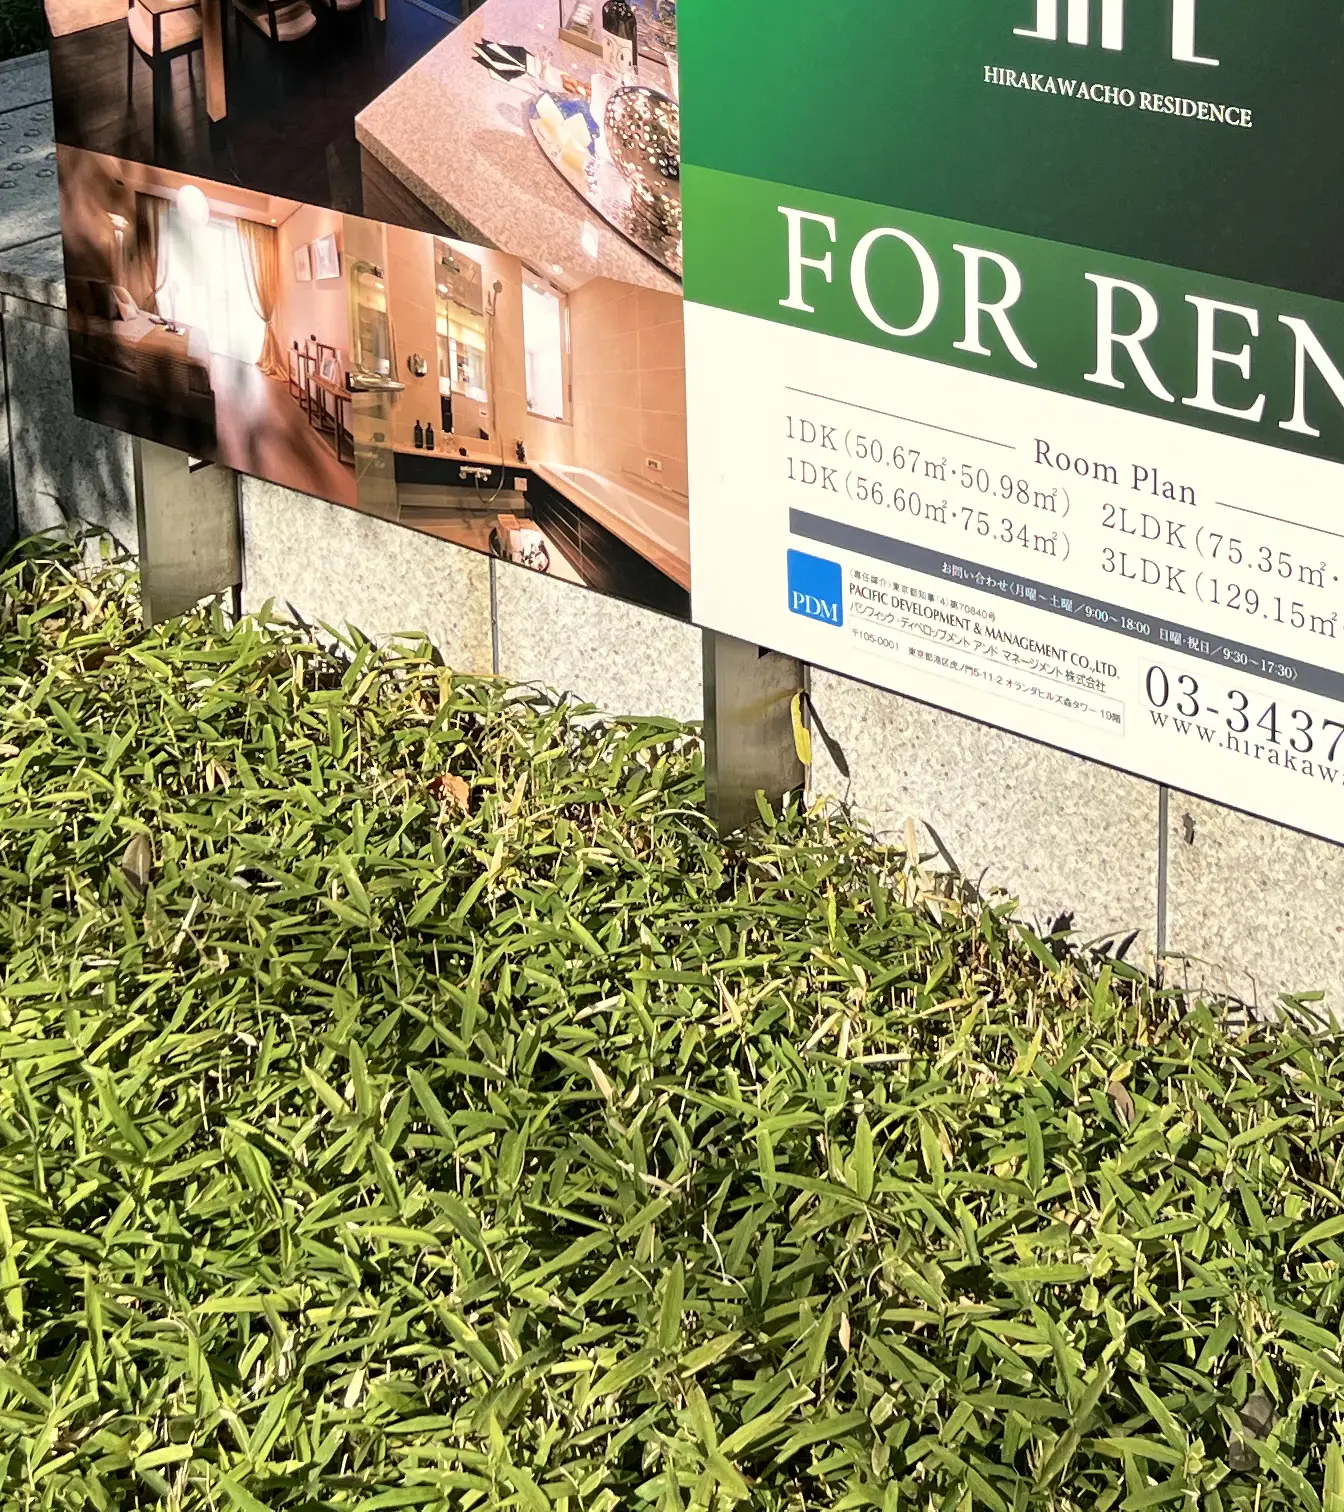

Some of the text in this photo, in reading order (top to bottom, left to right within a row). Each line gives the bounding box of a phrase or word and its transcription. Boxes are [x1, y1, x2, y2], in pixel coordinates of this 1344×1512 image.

[983, 65, 1253, 129] HIRAKAWACHO RESIDENCE
[776, 204, 1037, 370] FOR
[1033, 438, 1198, 507] Room Plan
[792, 590, 839, 622] PDM
[849, 582, 889, 605] PACIFIC
[891, 596, 970, 631] DEVELOPMENT
[973, 622, 982, 635] &
[984, 625, 1068, 662] MANAGEMENT
[1065, 669, 1107, 694] 株式会社
